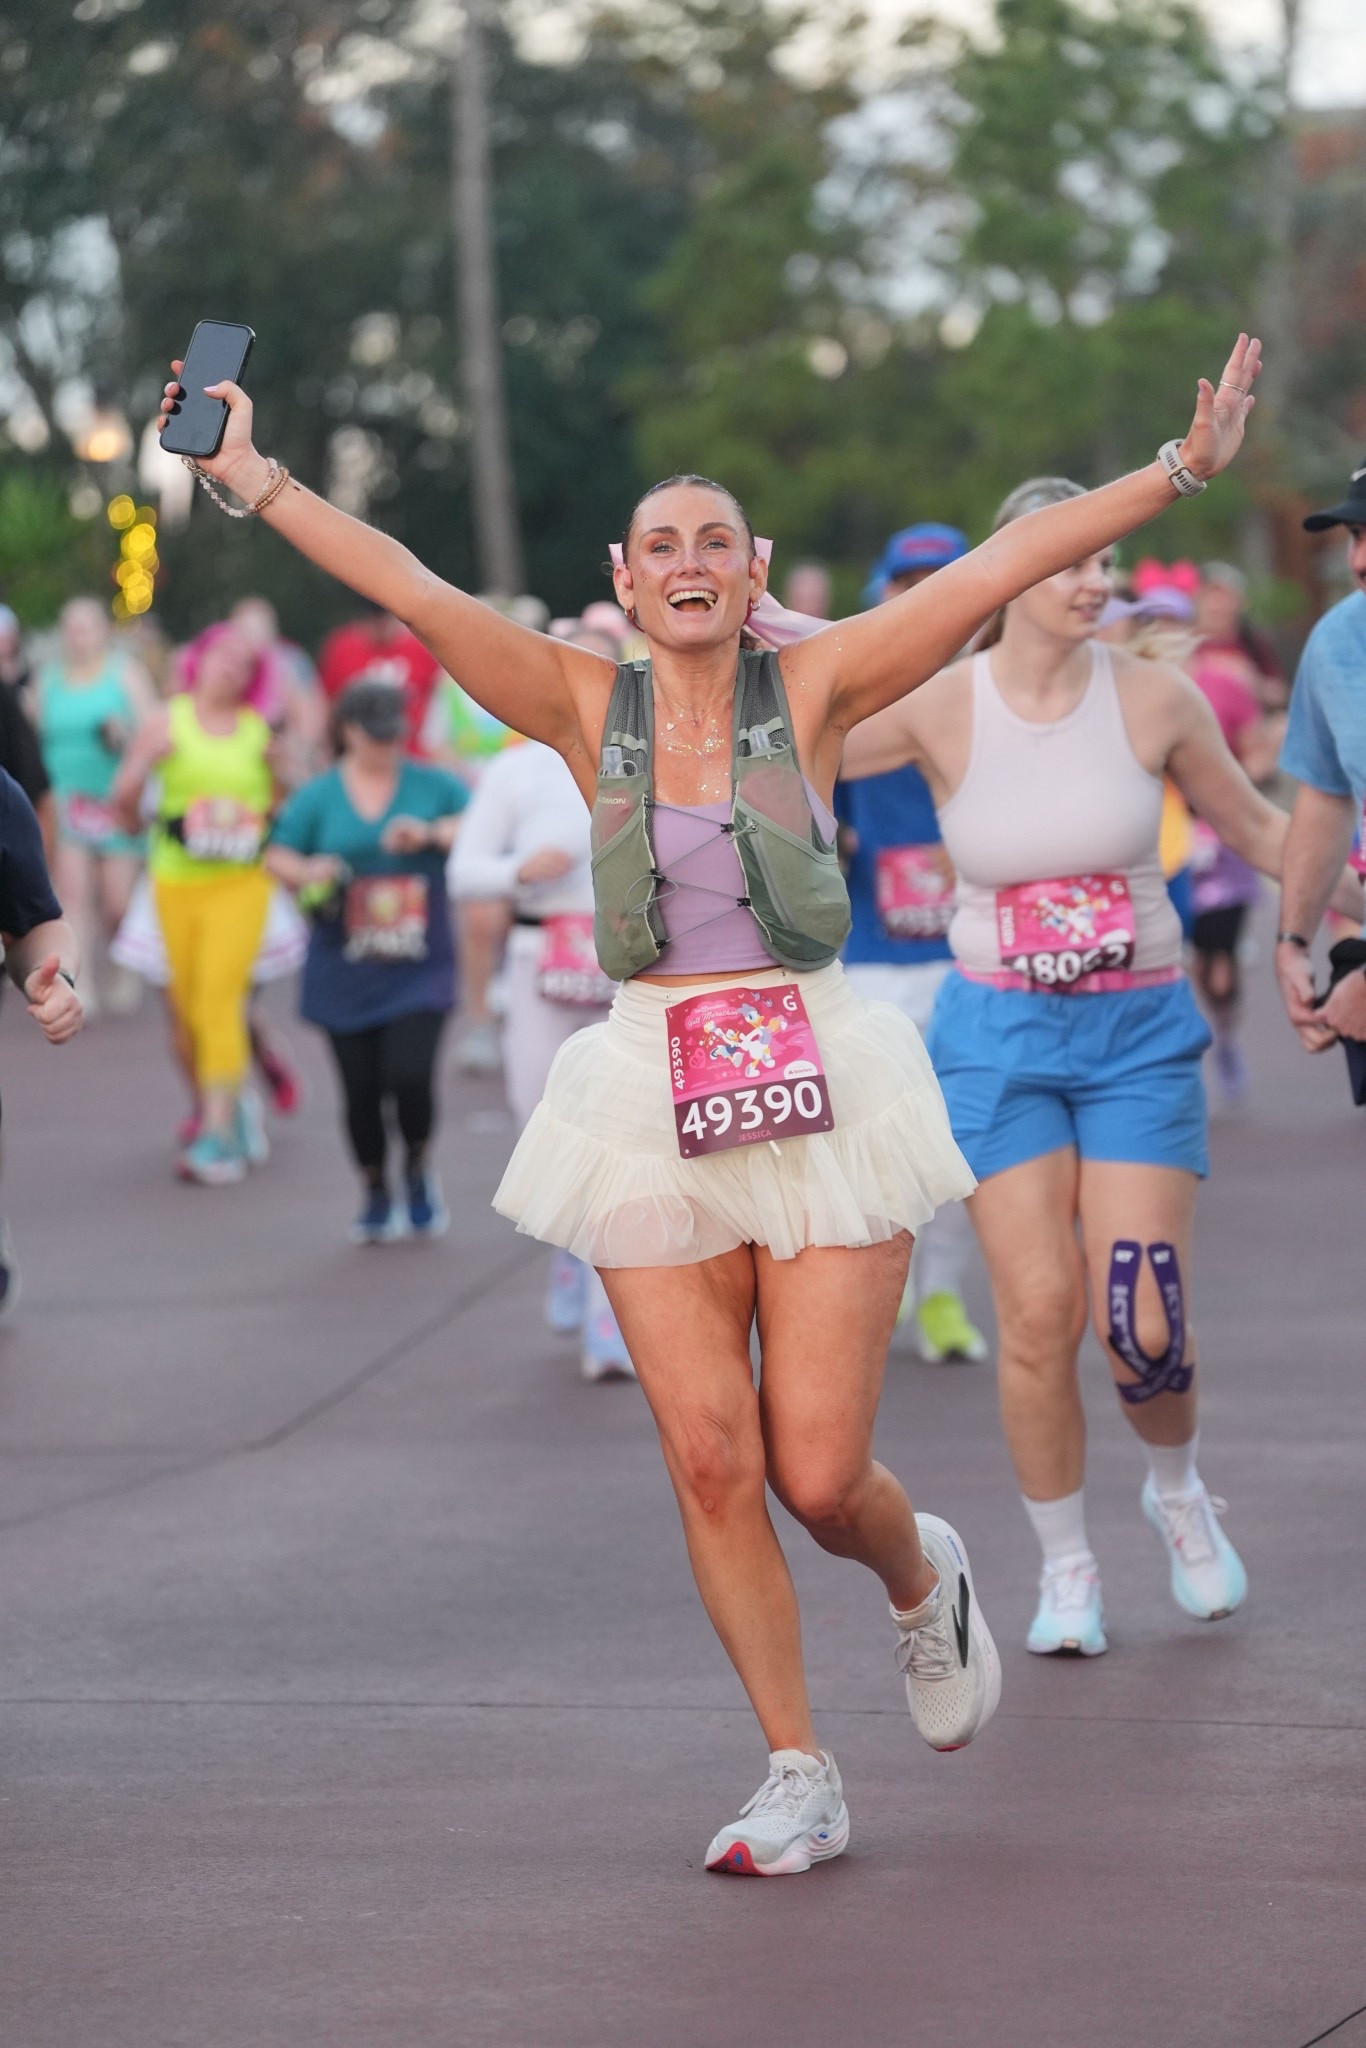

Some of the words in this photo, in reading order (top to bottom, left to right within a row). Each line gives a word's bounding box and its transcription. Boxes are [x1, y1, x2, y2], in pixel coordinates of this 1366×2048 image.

[783, 995, 798, 1011] G
[701, 1008, 738, 1020] Marathon
[671, 1036, 685, 1090] 49390
[682, 1080, 822, 1140] 49390
[739, 1129, 772, 1142] JESSICA
